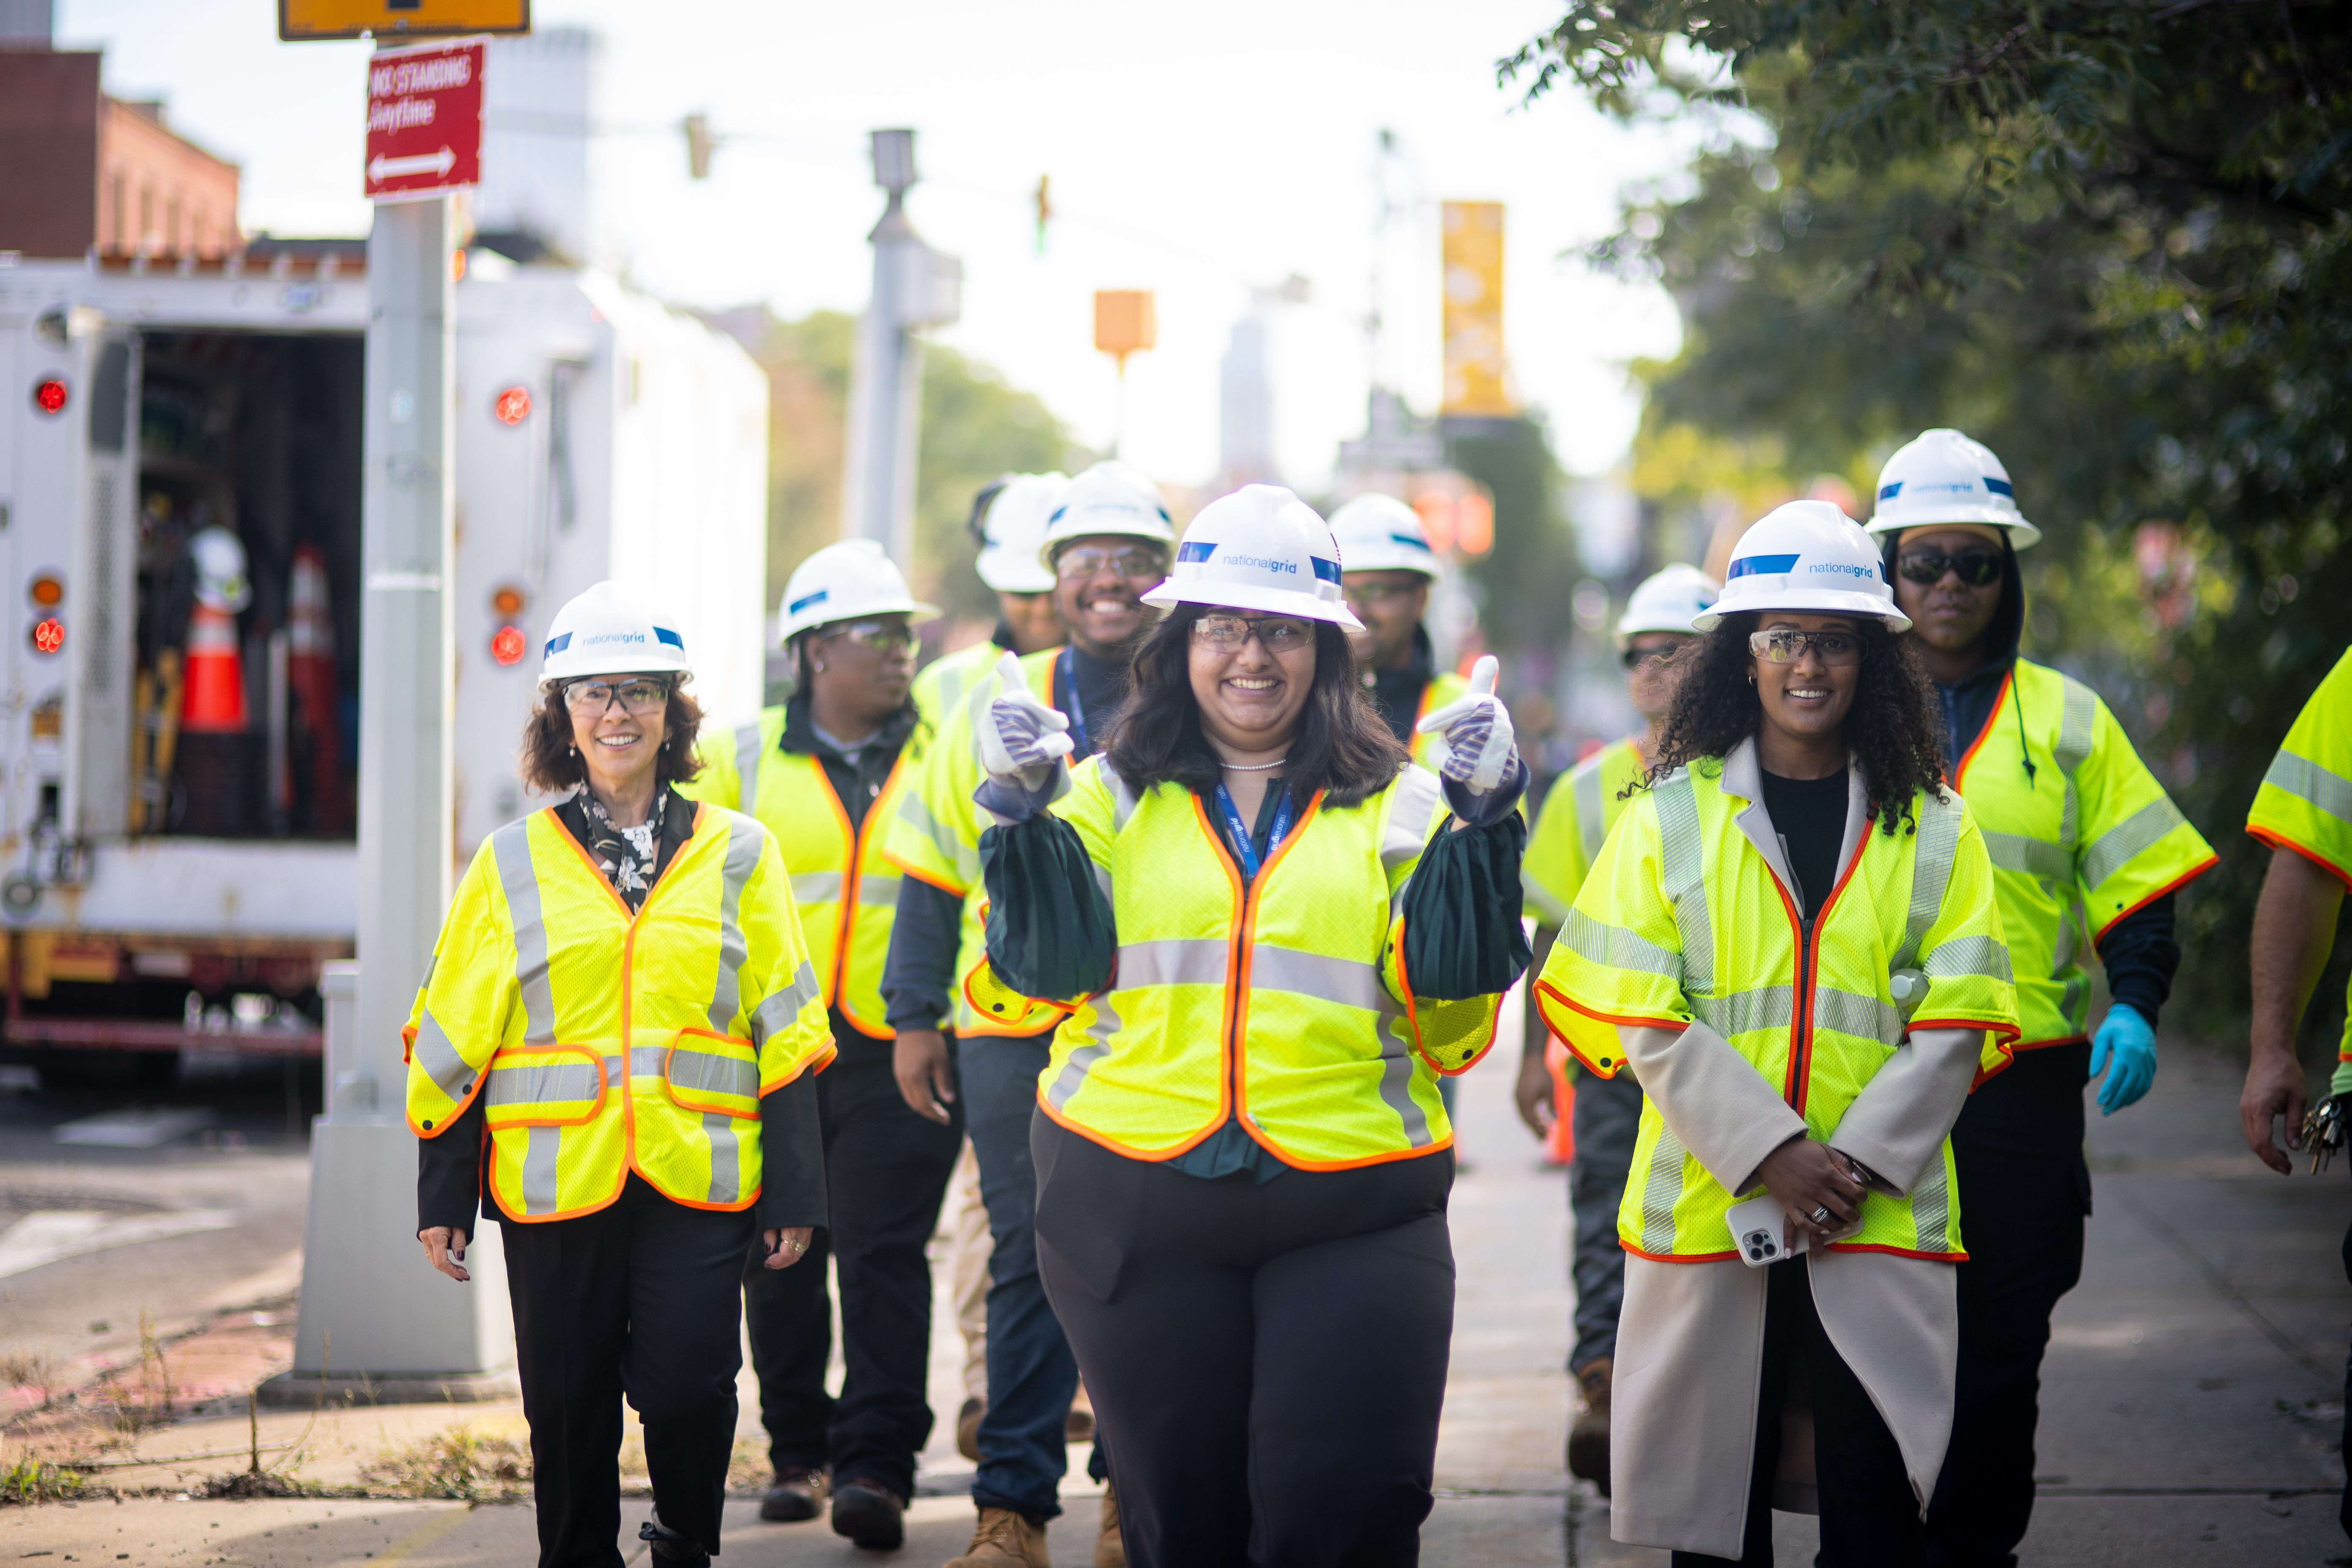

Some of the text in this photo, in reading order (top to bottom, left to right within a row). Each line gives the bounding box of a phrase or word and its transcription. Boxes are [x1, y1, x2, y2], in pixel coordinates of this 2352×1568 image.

[370, 54, 472, 99] NO STANDING
[368, 94, 437, 136] Anytime
[1910, 480, 1973, 495] nationalgrid
[1223, 555, 1297, 574] nationalgrid
[1810, 562, 1873, 578] nationalgrid
[583, 631, 645, 647] nationalgrid
[1230, 817, 1251, 853] nationalgrid
